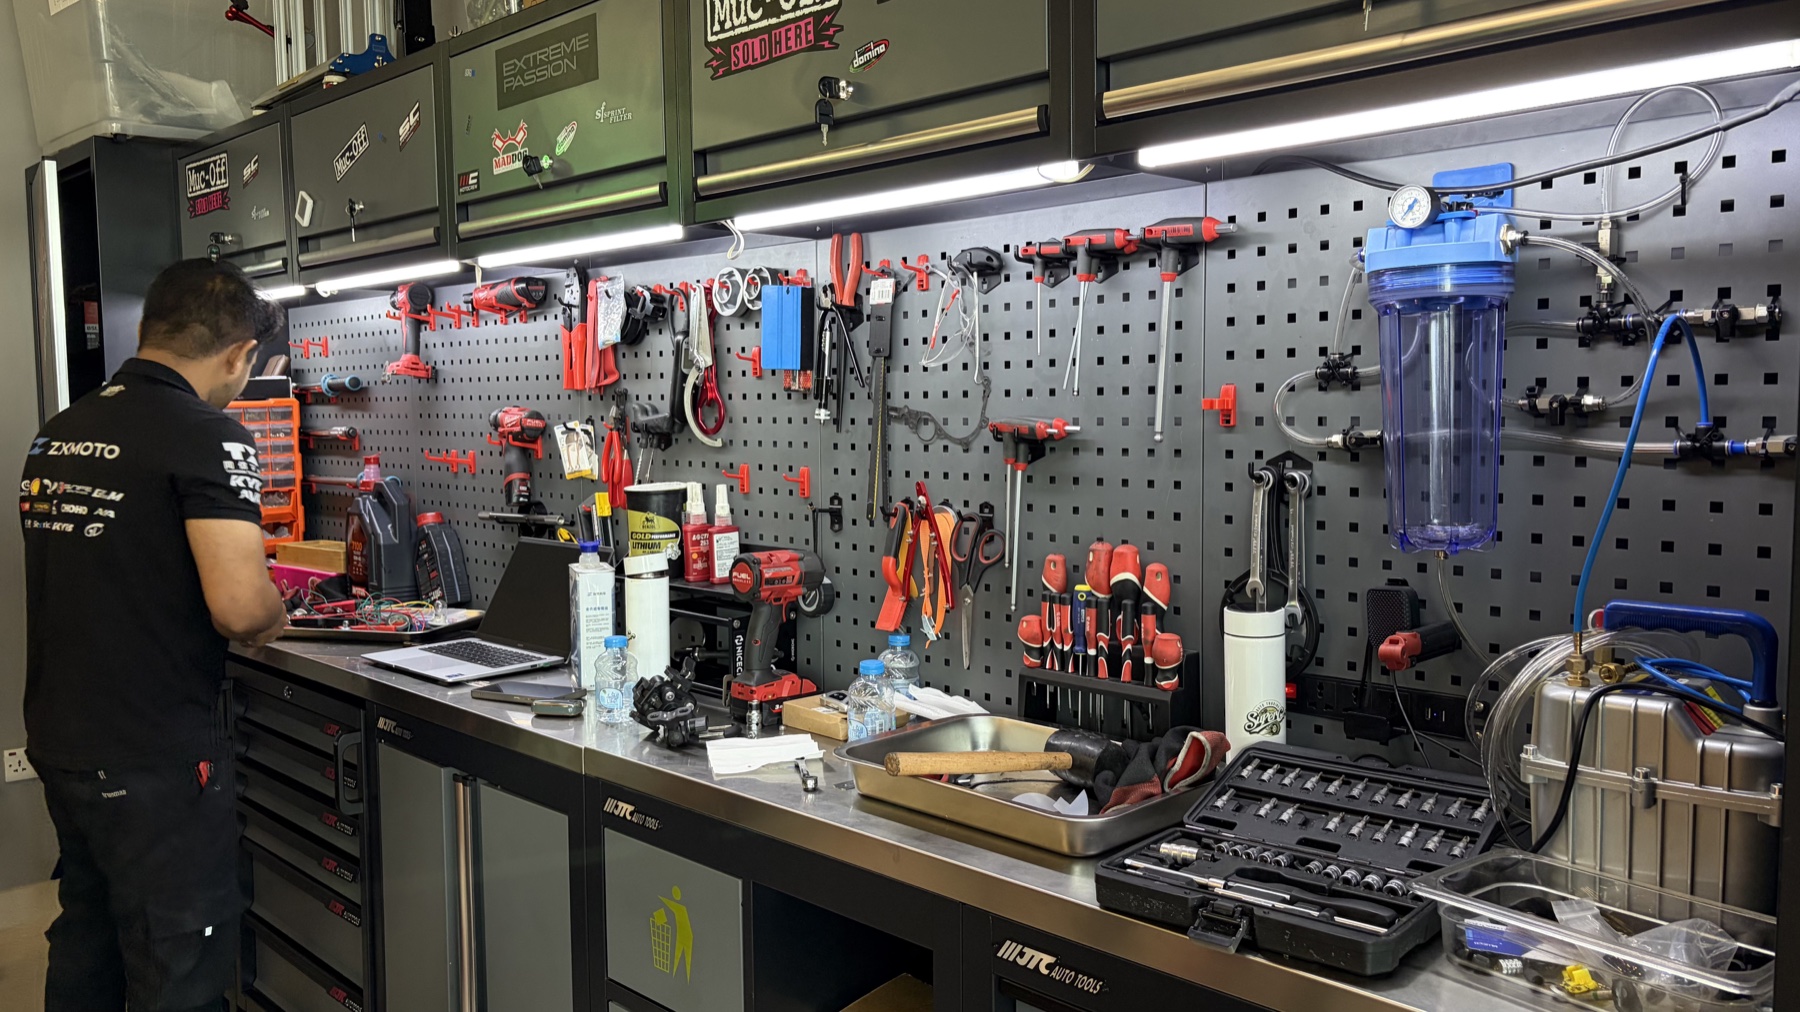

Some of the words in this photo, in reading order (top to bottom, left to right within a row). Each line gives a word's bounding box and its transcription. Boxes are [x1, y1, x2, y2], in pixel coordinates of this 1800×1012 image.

[503, 33, 590, 77] EXTREME
[732, 35, 769, 70] SOLD
[772, 18, 814, 57] HERE
[853, 42, 886, 68] domino
[503, 56, 577, 93] PASSION
[604, 107, 626, 118] SPRINT
[610, 112, 632, 123] FILTER
[335, 127, 369, 177] Muc-Off
[188, 158, 226, 192] Muc-Off
[47, 441, 121, 460] ZXMOTO
[632, 532, 652, 540] GOLD
[632, 541, 662, 551] LITHIUM
[732, 572, 751, 580] FUEL
[632, 812, 645, 825] AUTO
[644, 816, 660, 830] TOOLS
[1050, 966, 1075, 984] AUTO
[1074, 974, 1104, 994] TOOLS
